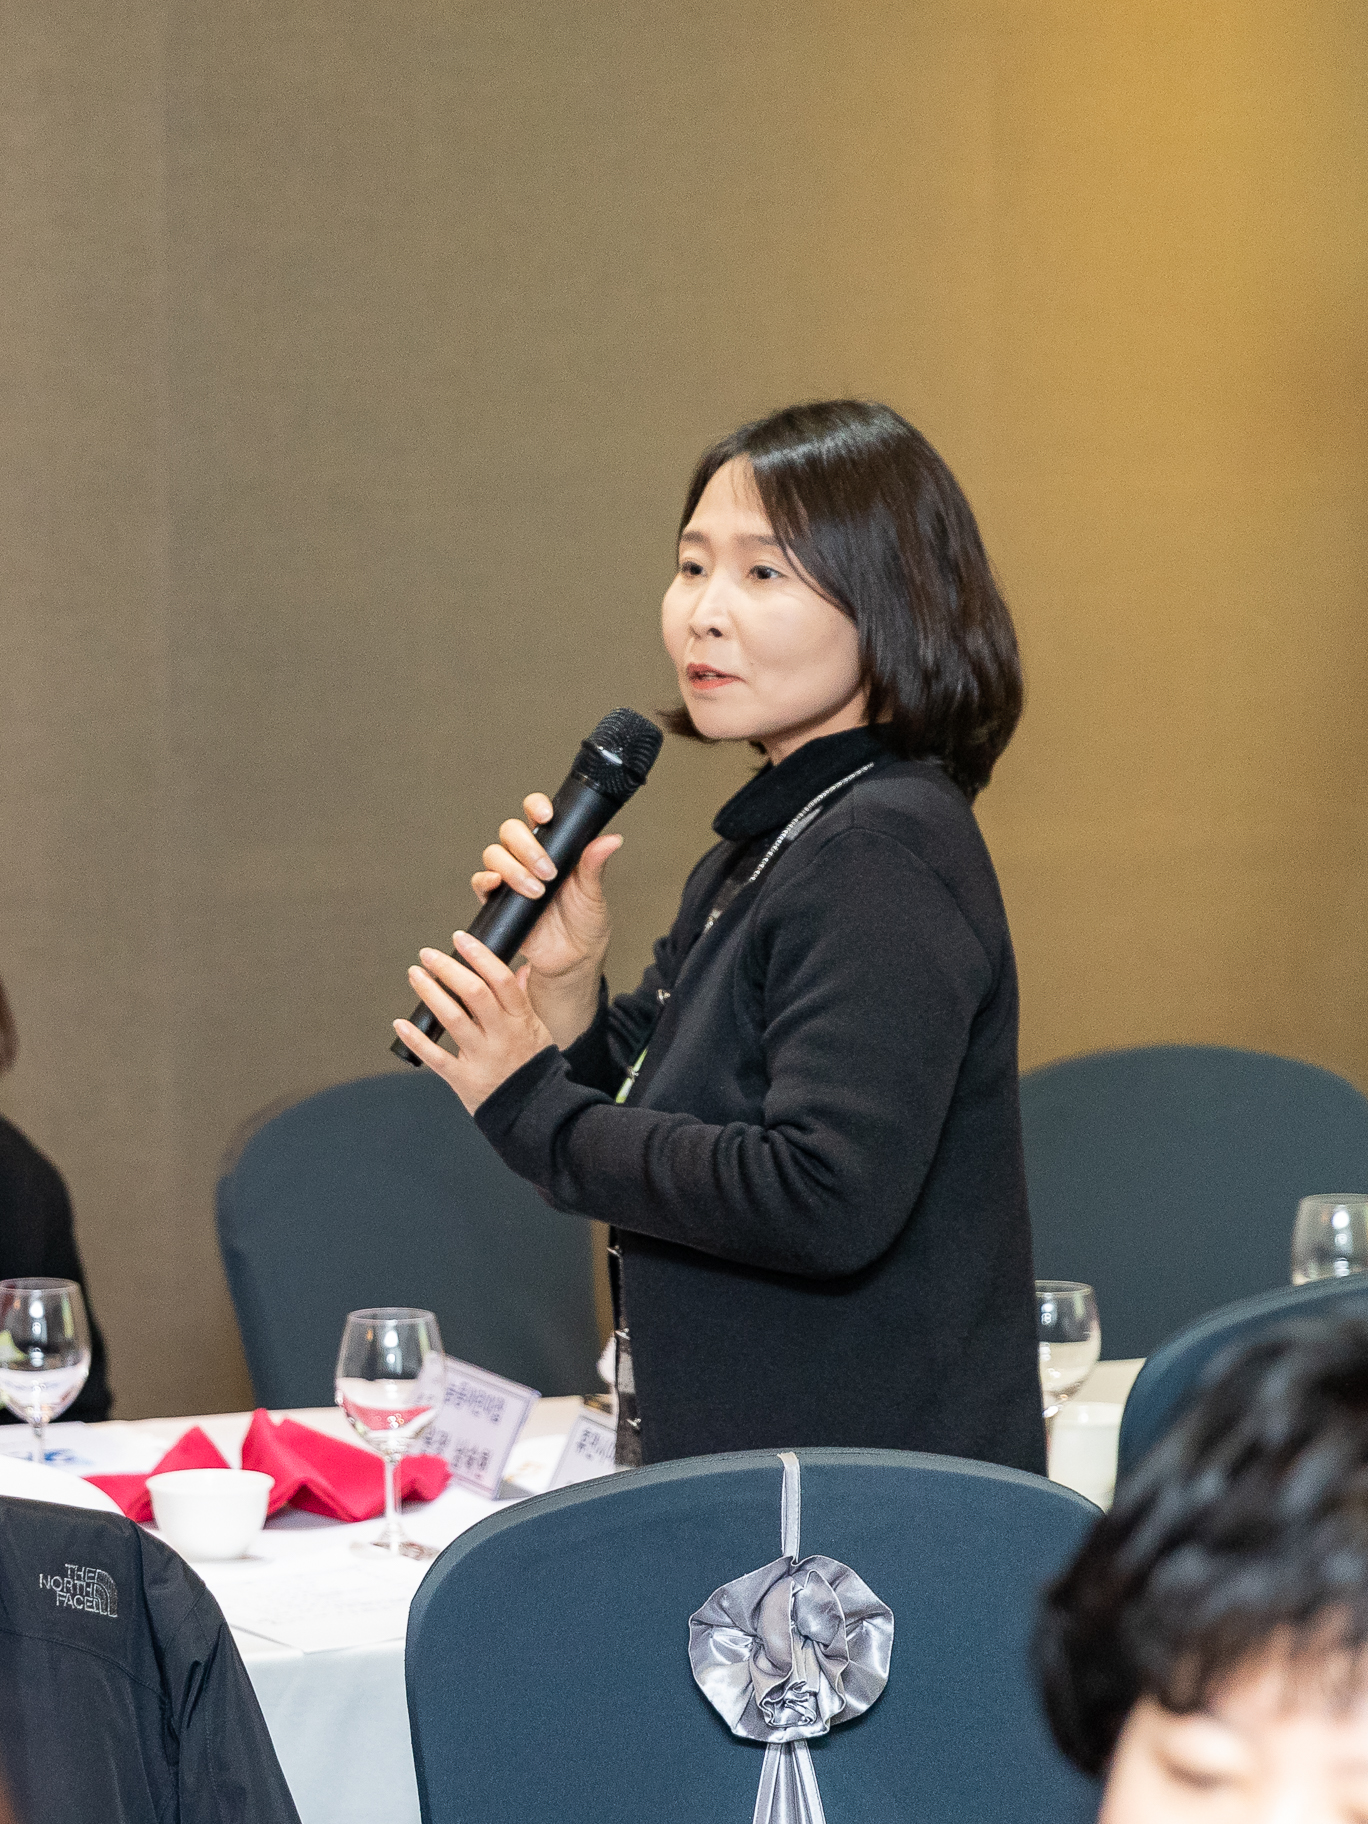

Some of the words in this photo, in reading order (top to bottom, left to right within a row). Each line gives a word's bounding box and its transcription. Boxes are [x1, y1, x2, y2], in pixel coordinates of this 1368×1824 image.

[65, 1563, 96, 1583] THE
[39, 1573, 94, 1598] NORTH
[56, 1591, 94, 1612] FACE
